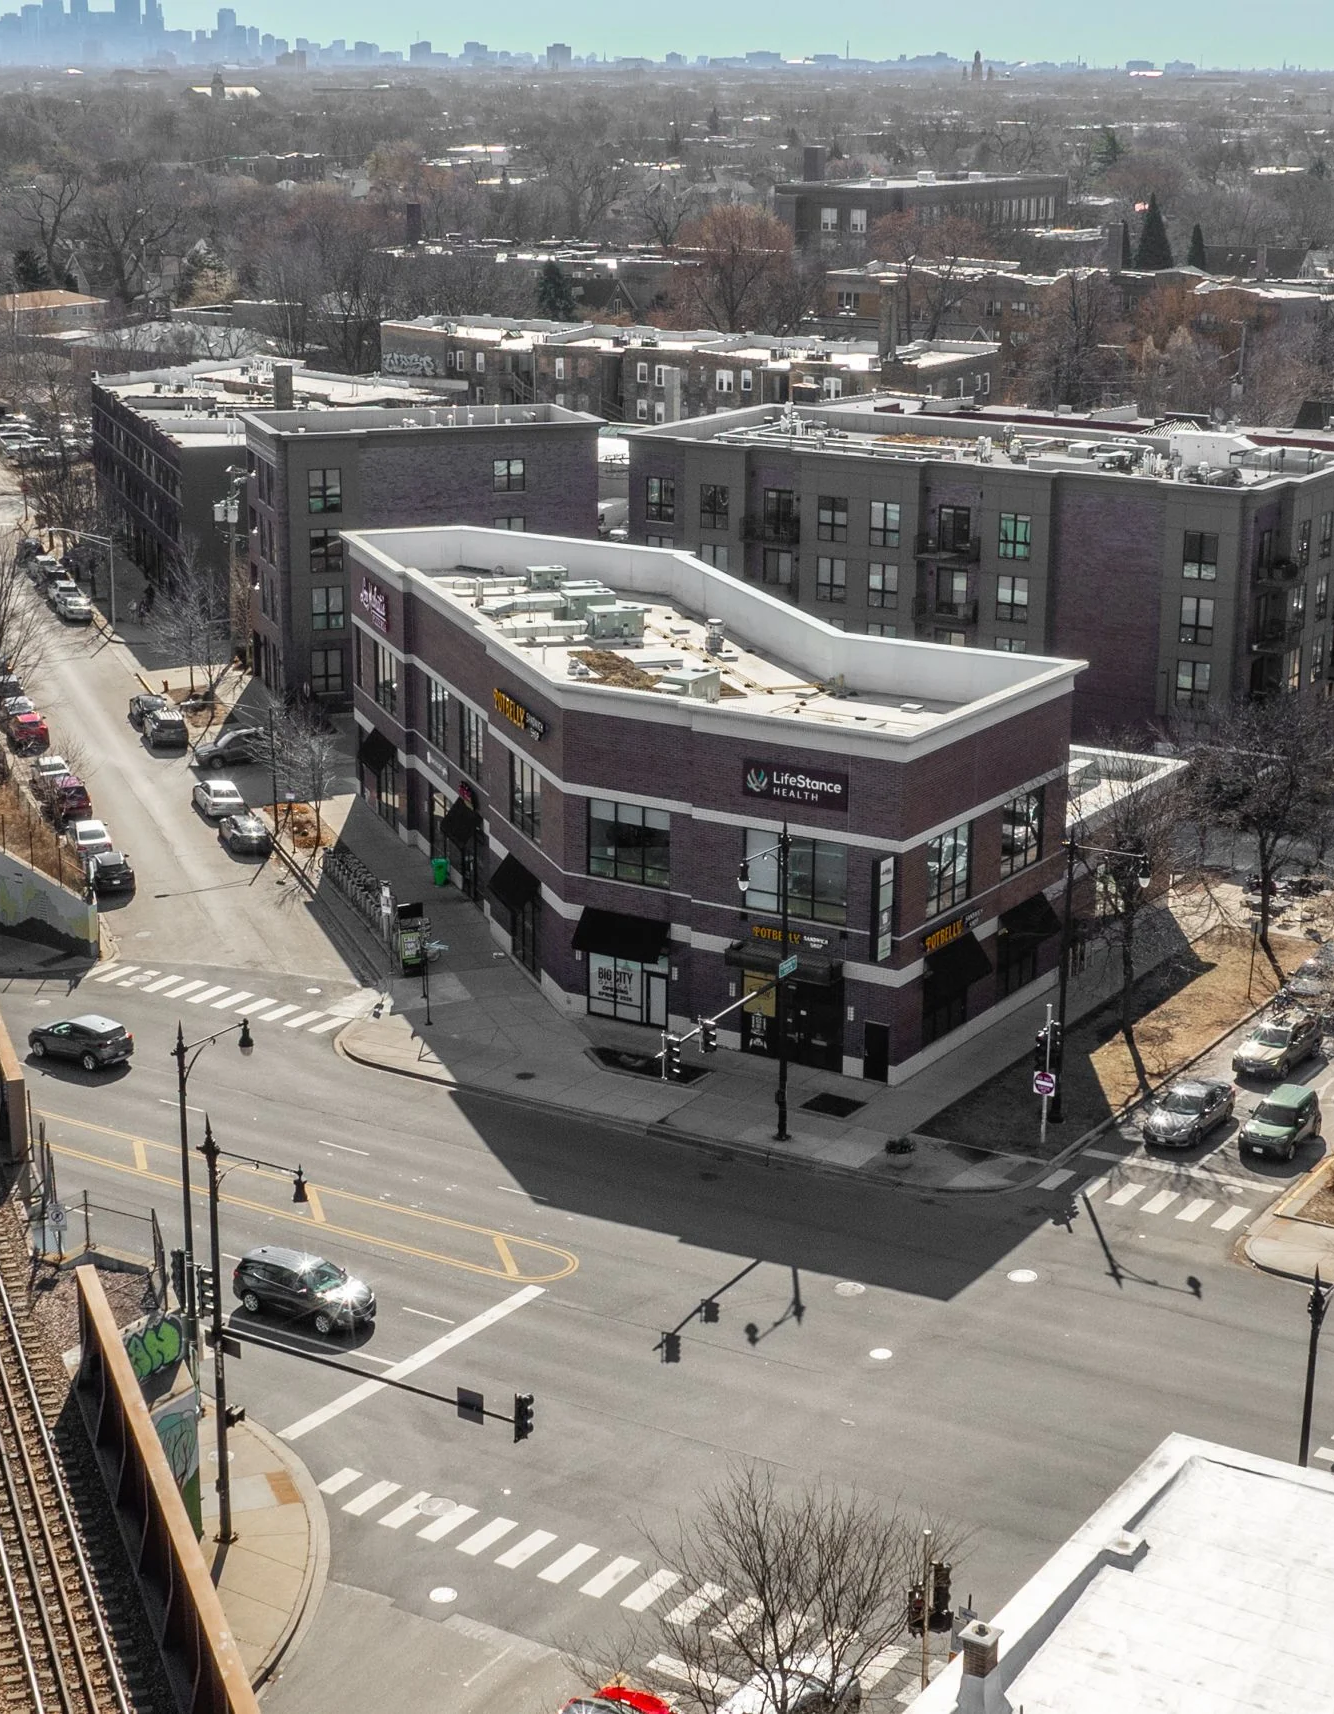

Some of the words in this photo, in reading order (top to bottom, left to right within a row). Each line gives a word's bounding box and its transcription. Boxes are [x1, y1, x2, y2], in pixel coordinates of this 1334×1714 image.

[492, 687, 525, 731] POTBELLY
[772, 771, 842, 794] LifeStance
[772, 786, 819, 801] HEALTH
[752, 926, 802, 945] POTBELY
[924, 918, 965, 953] POTBELLY
[598, 966, 612, 981] BIG
[614, 970, 633, 985] CITY
